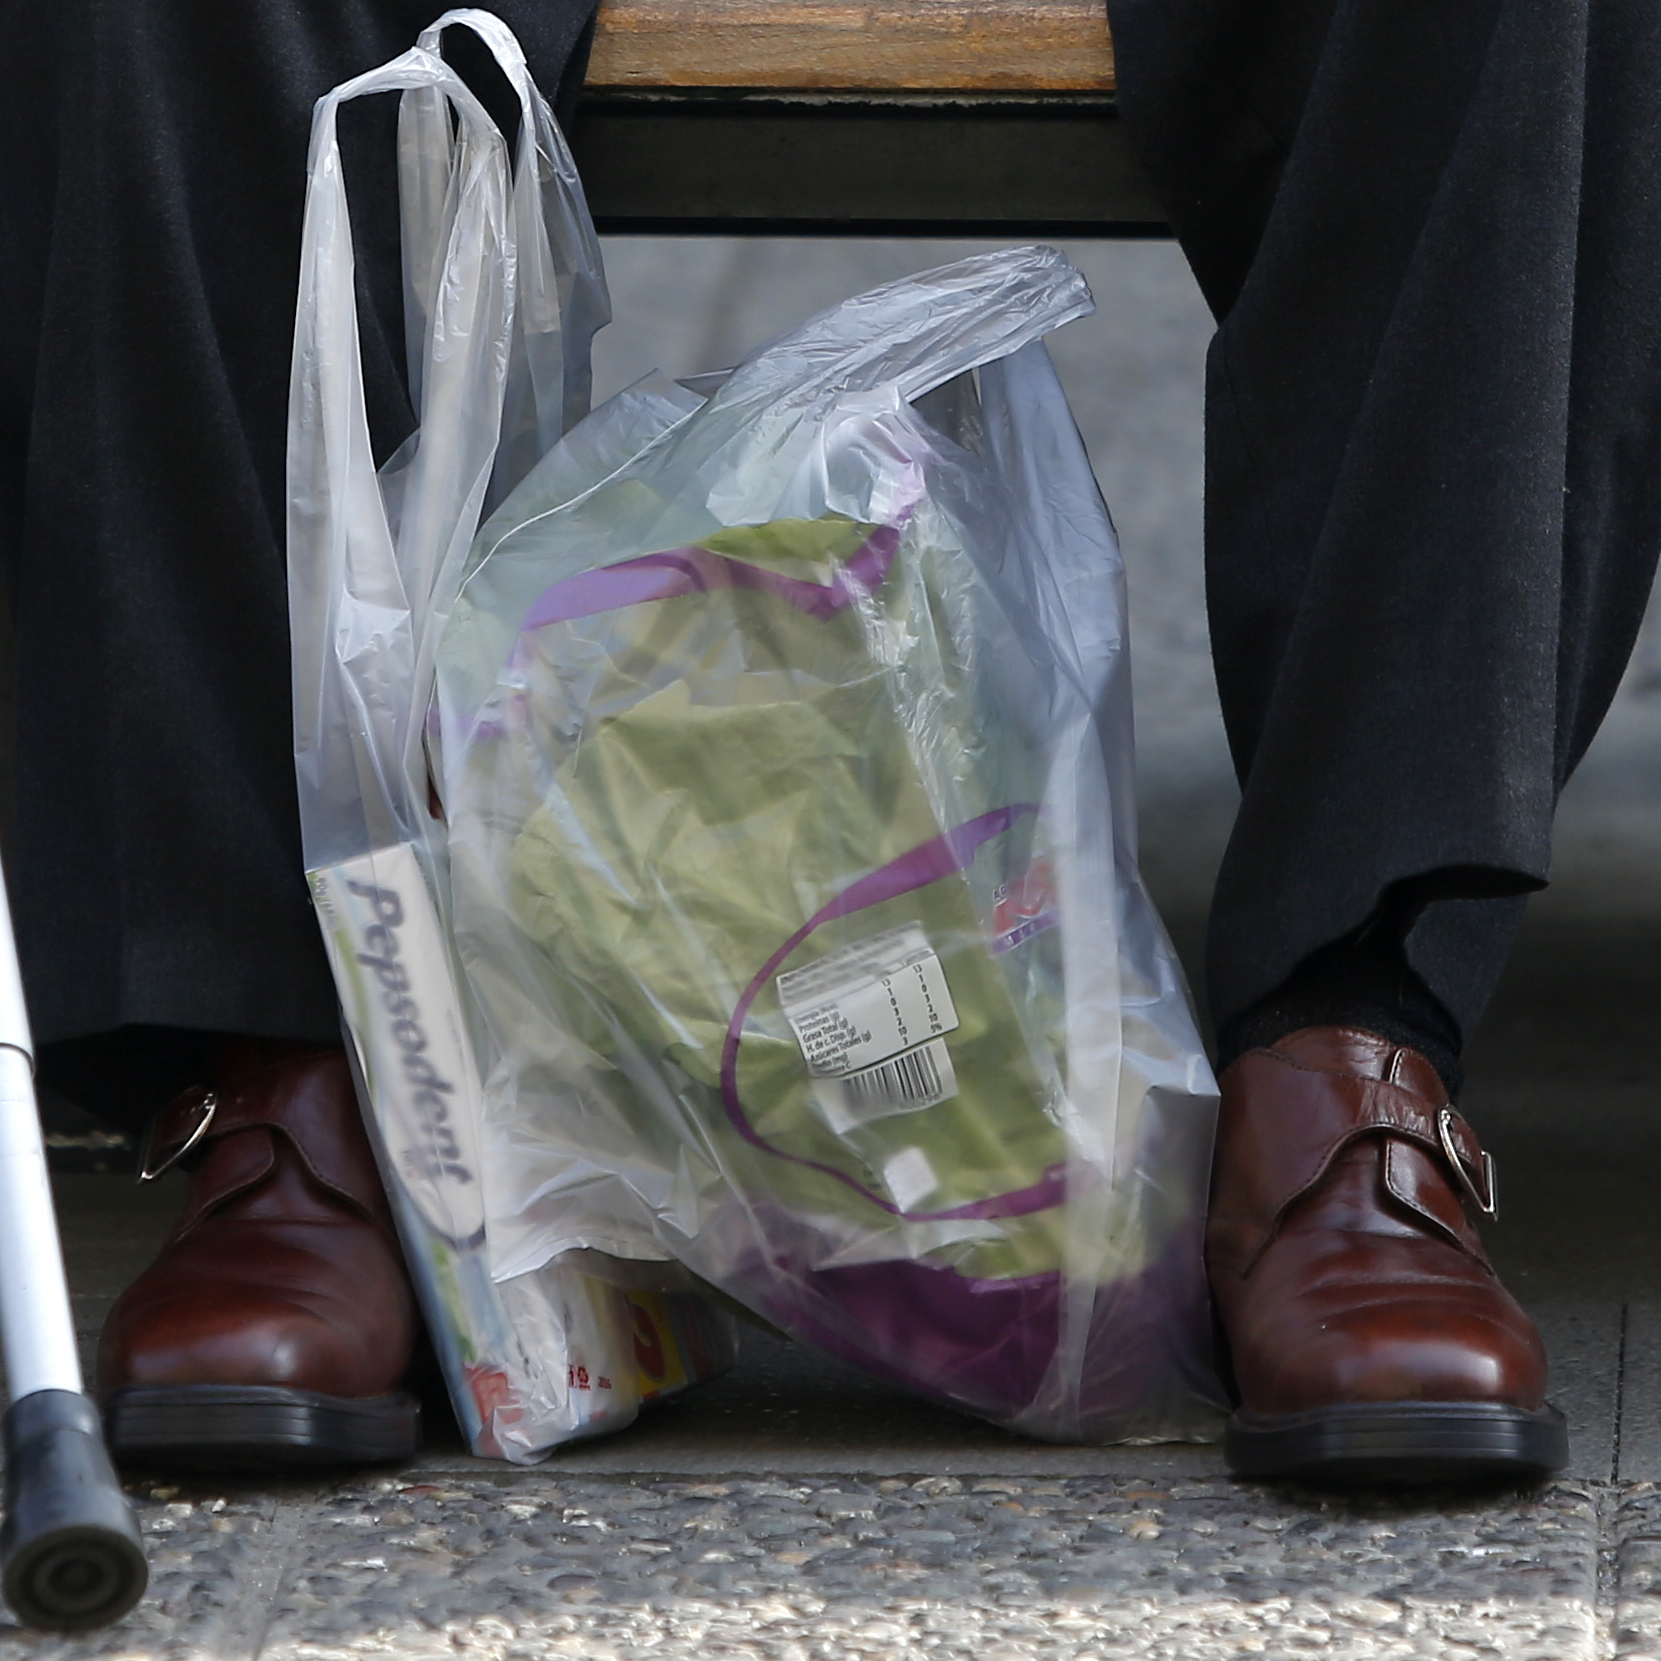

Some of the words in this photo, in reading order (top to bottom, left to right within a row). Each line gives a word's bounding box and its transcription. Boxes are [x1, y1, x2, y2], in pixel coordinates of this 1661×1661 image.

[887, 987, 892, 996] 1
[919, 974, 924, 983] 1
[345, 878, 473, 1184] Pepsodent
[802, 1030, 822, 1043] Grasa
[821, 1023, 838, 1034] Total
[890, 998, 896, 1006] 0
[922, 984, 927, 993] 0
[838, 1036, 862, 1049] Totales
[928, 1004, 933, 1013] 2
[898, 1026, 907, 1036] 10
[929, 1013, 938, 1022] 10
